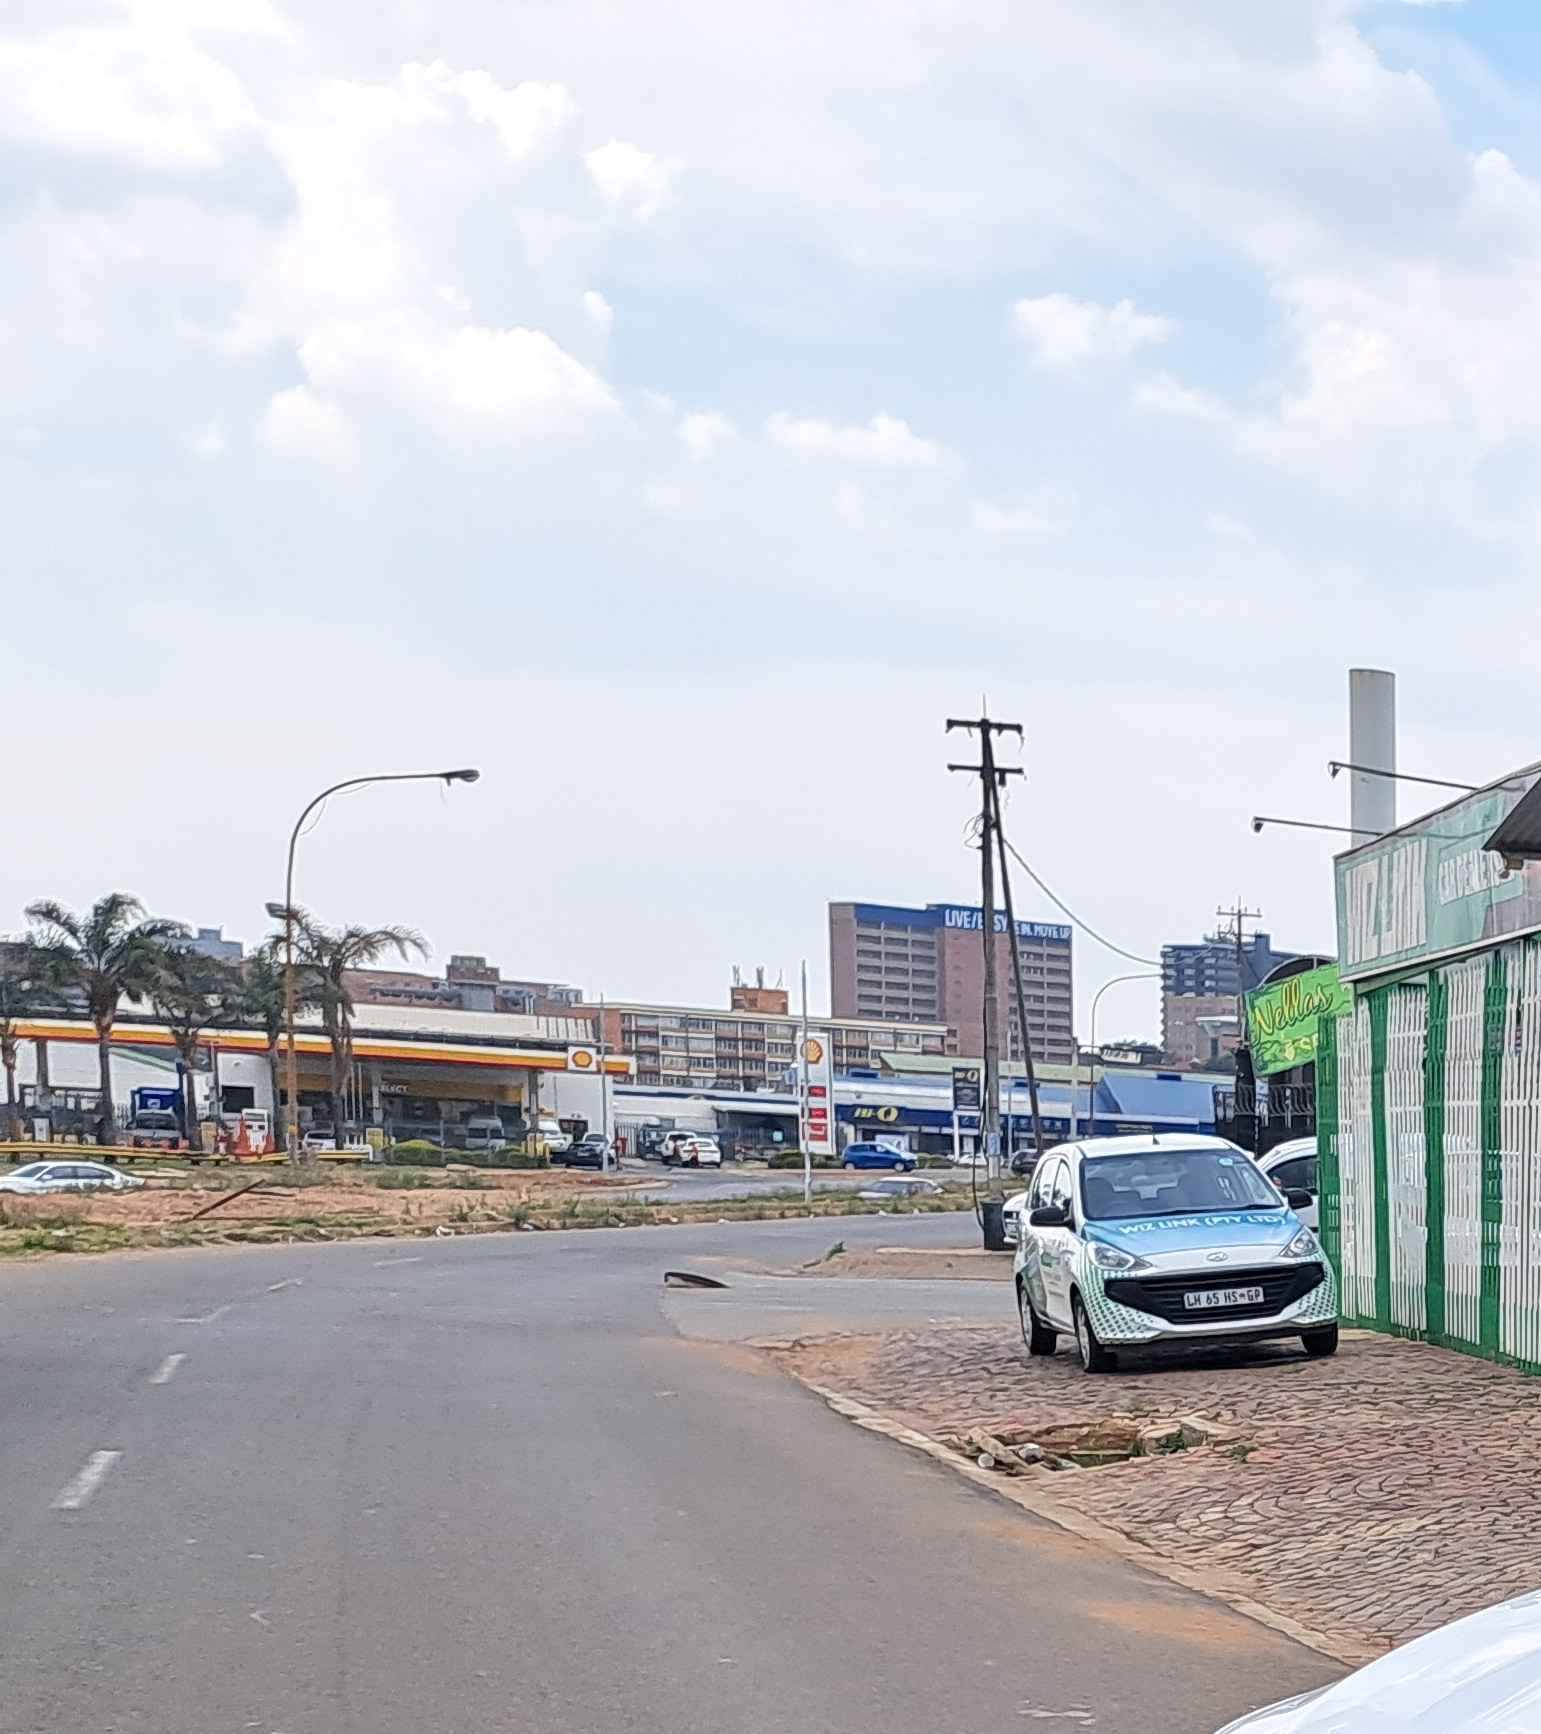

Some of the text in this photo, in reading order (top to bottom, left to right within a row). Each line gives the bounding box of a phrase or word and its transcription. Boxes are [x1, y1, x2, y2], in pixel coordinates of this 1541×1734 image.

[1252, 976, 1333, 1048] Nellas
[1119, 1214, 1288, 1234] WIZ LINK (PTY LTD)
[1206, 1292, 1220, 1306] 65
[1247, 1288, 1261, 1302] GP
